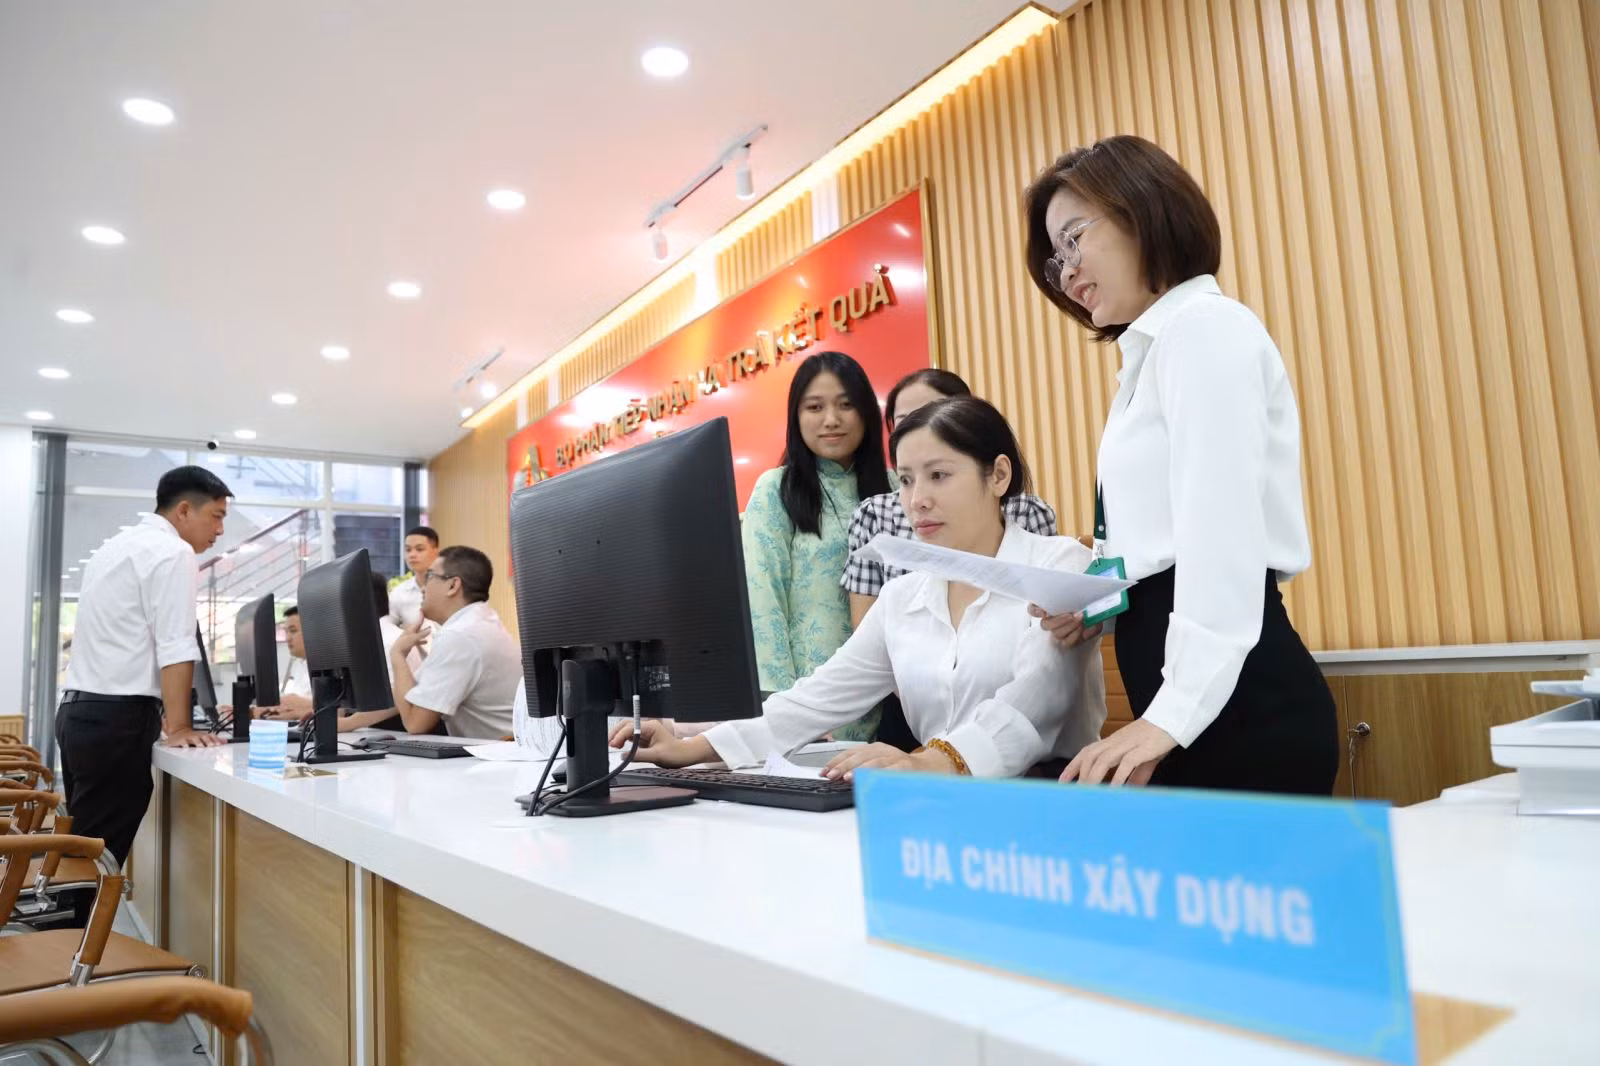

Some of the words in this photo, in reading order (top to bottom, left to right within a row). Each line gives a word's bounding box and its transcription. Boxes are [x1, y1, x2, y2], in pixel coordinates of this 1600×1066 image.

[829, 263, 894, 332] QUẢ
[900, 837, 953, 890] ĐỊA
[961, 842, 1073, 905] CHÍNH
[1082, 853, 1162, 919] XÂY
[1175, 872, 1315, 945] DỰNG
